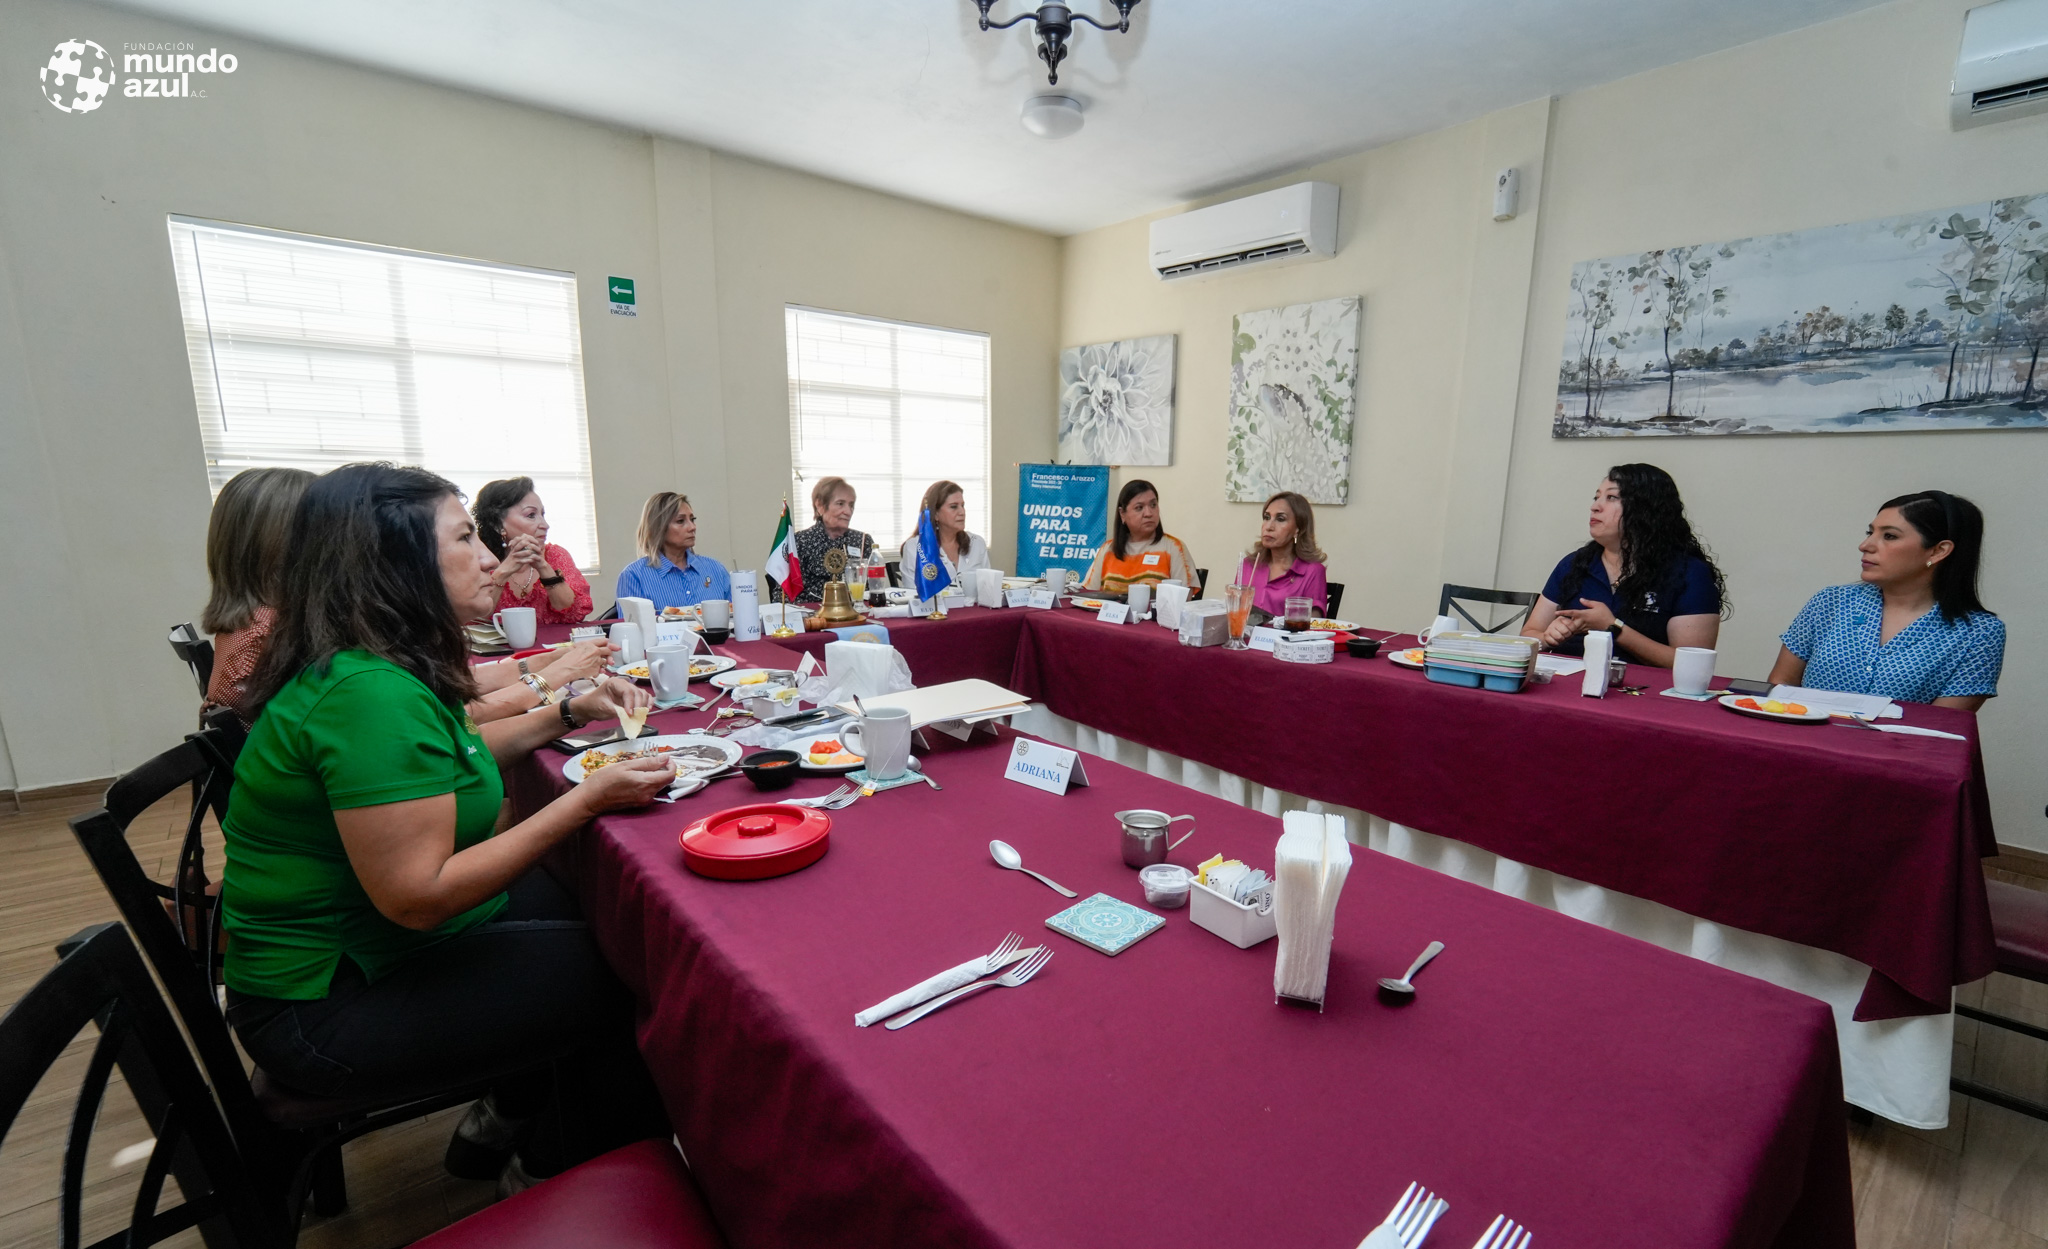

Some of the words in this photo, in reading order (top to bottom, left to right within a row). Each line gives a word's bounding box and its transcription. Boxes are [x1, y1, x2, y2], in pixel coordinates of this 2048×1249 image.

[1031, 473, 1069, 481] Francesco
[1023, 503, 1083, 518] UNIDOS
[1029, 518, 1071, 531] PARA
[1034, 532, 1088, 545] HACER
[1039, 546, 1059, 559] EL
[1062, 546, 1098, 560] BIEN
[1013, 761, 1061, 783] ADRIANA
